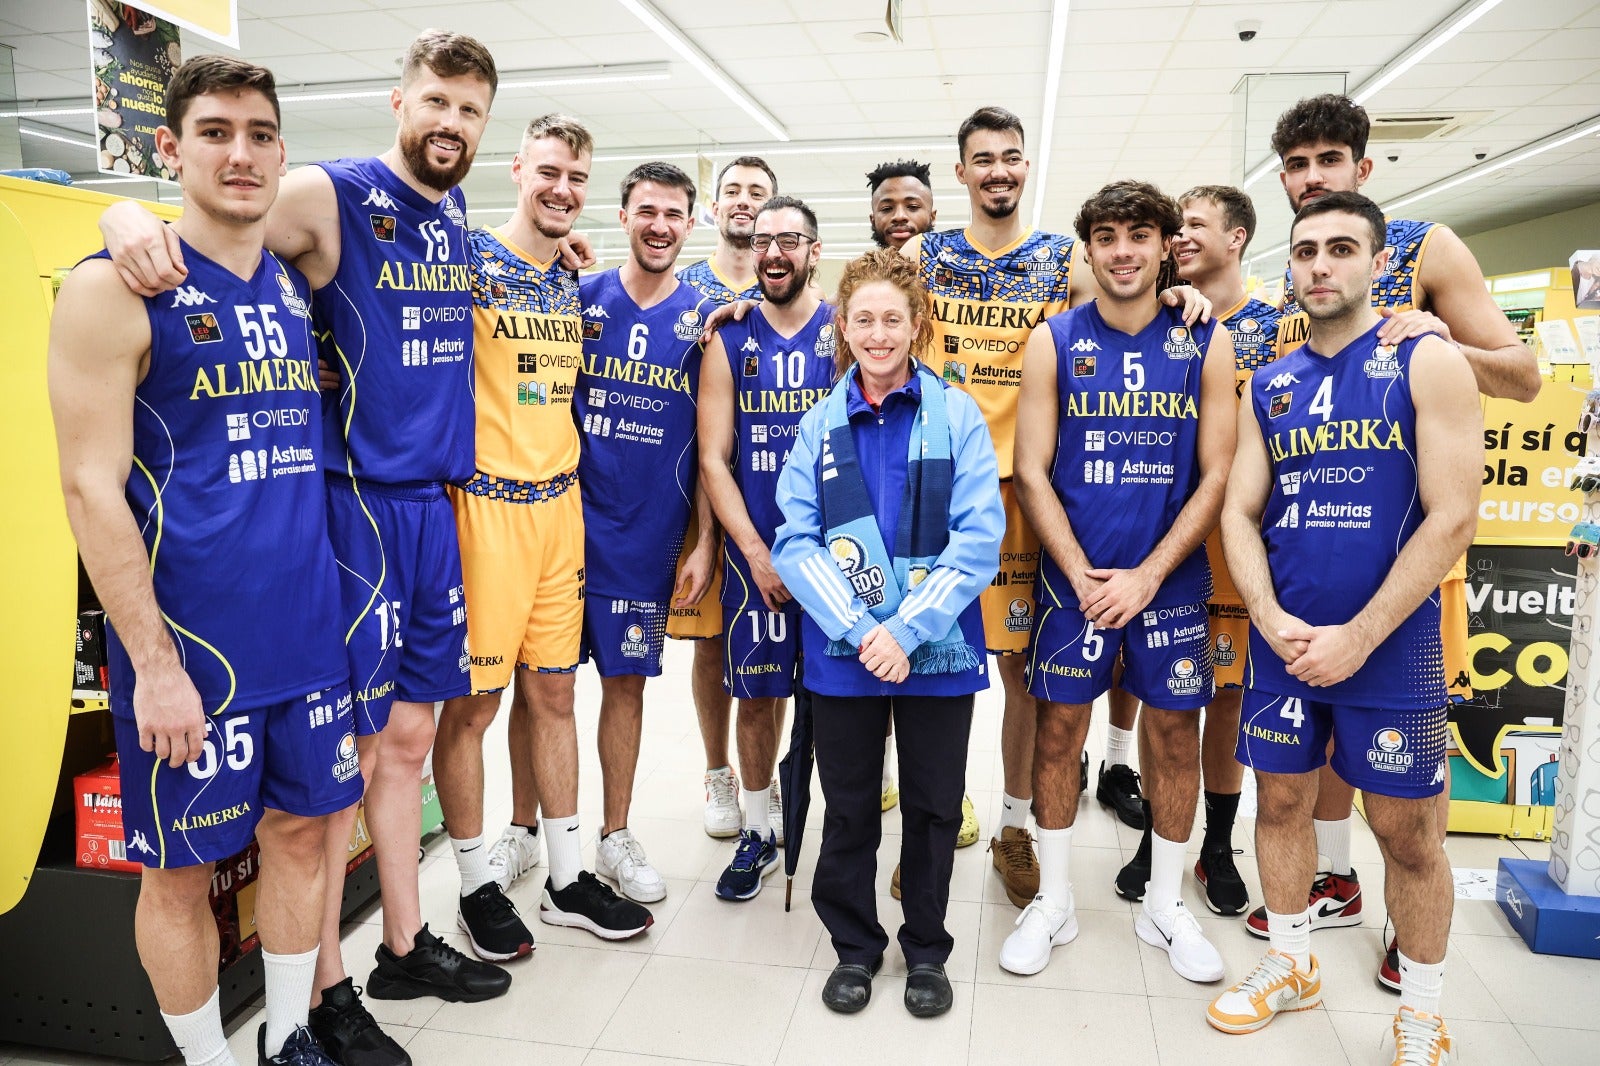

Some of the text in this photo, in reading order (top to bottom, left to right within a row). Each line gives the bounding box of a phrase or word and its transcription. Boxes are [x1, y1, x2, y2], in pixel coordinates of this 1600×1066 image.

[120, 72, 166, 96] ahorrar,
[122, 97, 166, 117] nuestro
[153, 92, 162, 104] lo
[418, 218, 450, 262] 15
[375, 260, 471, 292] ALIMERK
[1027, 262, 1057, 270] OVIEDO
[930, 299, 1046, 329] ALIMERKA
[234, 304, 288, 360] 55
[674, 324, 703, 335] OVIEDO
[1232, 333, 1264, 342] OVIEDO
[628, 323, 649, 360] 6
[1165, 342, 1195, 353] OVIEDO
[772, 351, 805, 388] 10
[972, 362, 1022, 379] Asturias
[1123, 352, 1145, 392] 5
[1067, 391, 1198, 419] ALIMERKA
[1272, 404, 1283, 412] LEB
[1308, 376, 1333, 422] 4
[616, 418, 664, 437] Asturias
[1484, 422, 1587, 457] sí sí q
[1122, 459, 1174, 475] Asturias
[1307, 500, 1372, 518] Asturias
[1478, 500, 1580, 523] curso
[1338, 519, 1371, 529] natural
[1466, 583, 1575, 616] Vuelt
[1006, 617, 1033, 626] OVIEDO
[1159, 604, 1200, 619] OVIEDO
[748, 610, 786, 643] 10
[1174, 623, 1205, 638] Asturias
[622, 642, 648, 652] OVIEDO
[1082, 621, 1106, 662] 5
[736, 663, 782, 675] ALIMERKA
[1038, 662, 1092, 678] ALIMERKA
[1468, 632, 1570, 690] Co
[1168, 678, 1201, 688] OVIEDO
[1280, 697, 1305, 728] 4
[1242, 722, 1300, 745] ALIMERKA
[1369, 751, 1411, 765] OVIEDO
[172, 801, 250, 832] ALIMERKA
